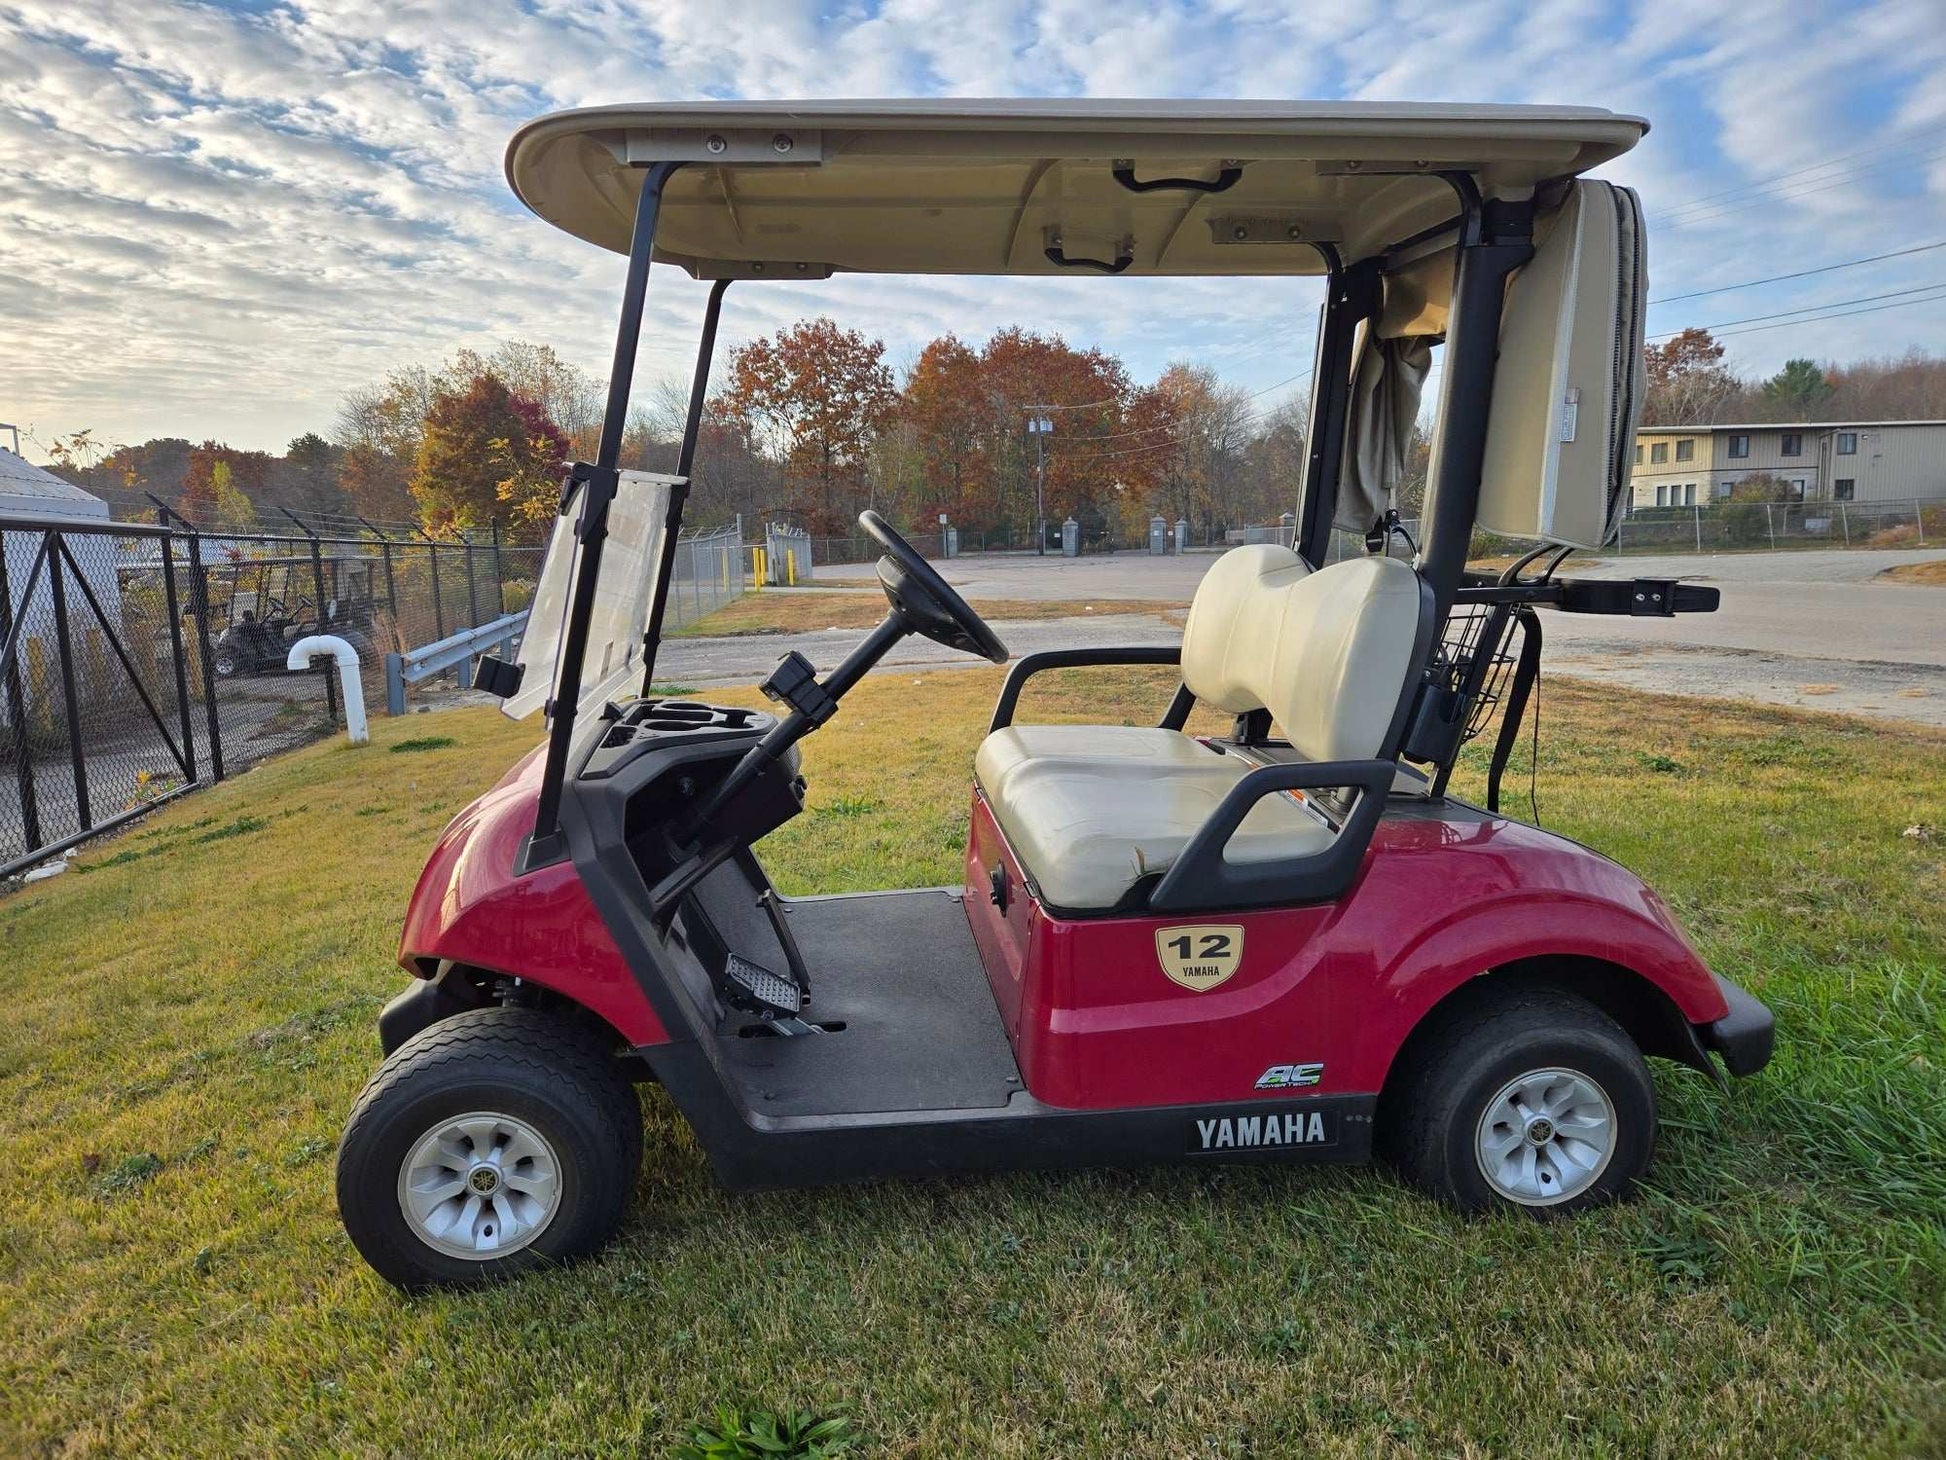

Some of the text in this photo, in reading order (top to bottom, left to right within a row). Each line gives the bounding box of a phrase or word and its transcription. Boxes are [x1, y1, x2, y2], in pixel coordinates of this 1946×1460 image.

[1168, 934, 1231, 959] 12
[1182, 966, 1220, 977] YAMAHA
[1197, 1112, 1326, 1149] YAMAHA
